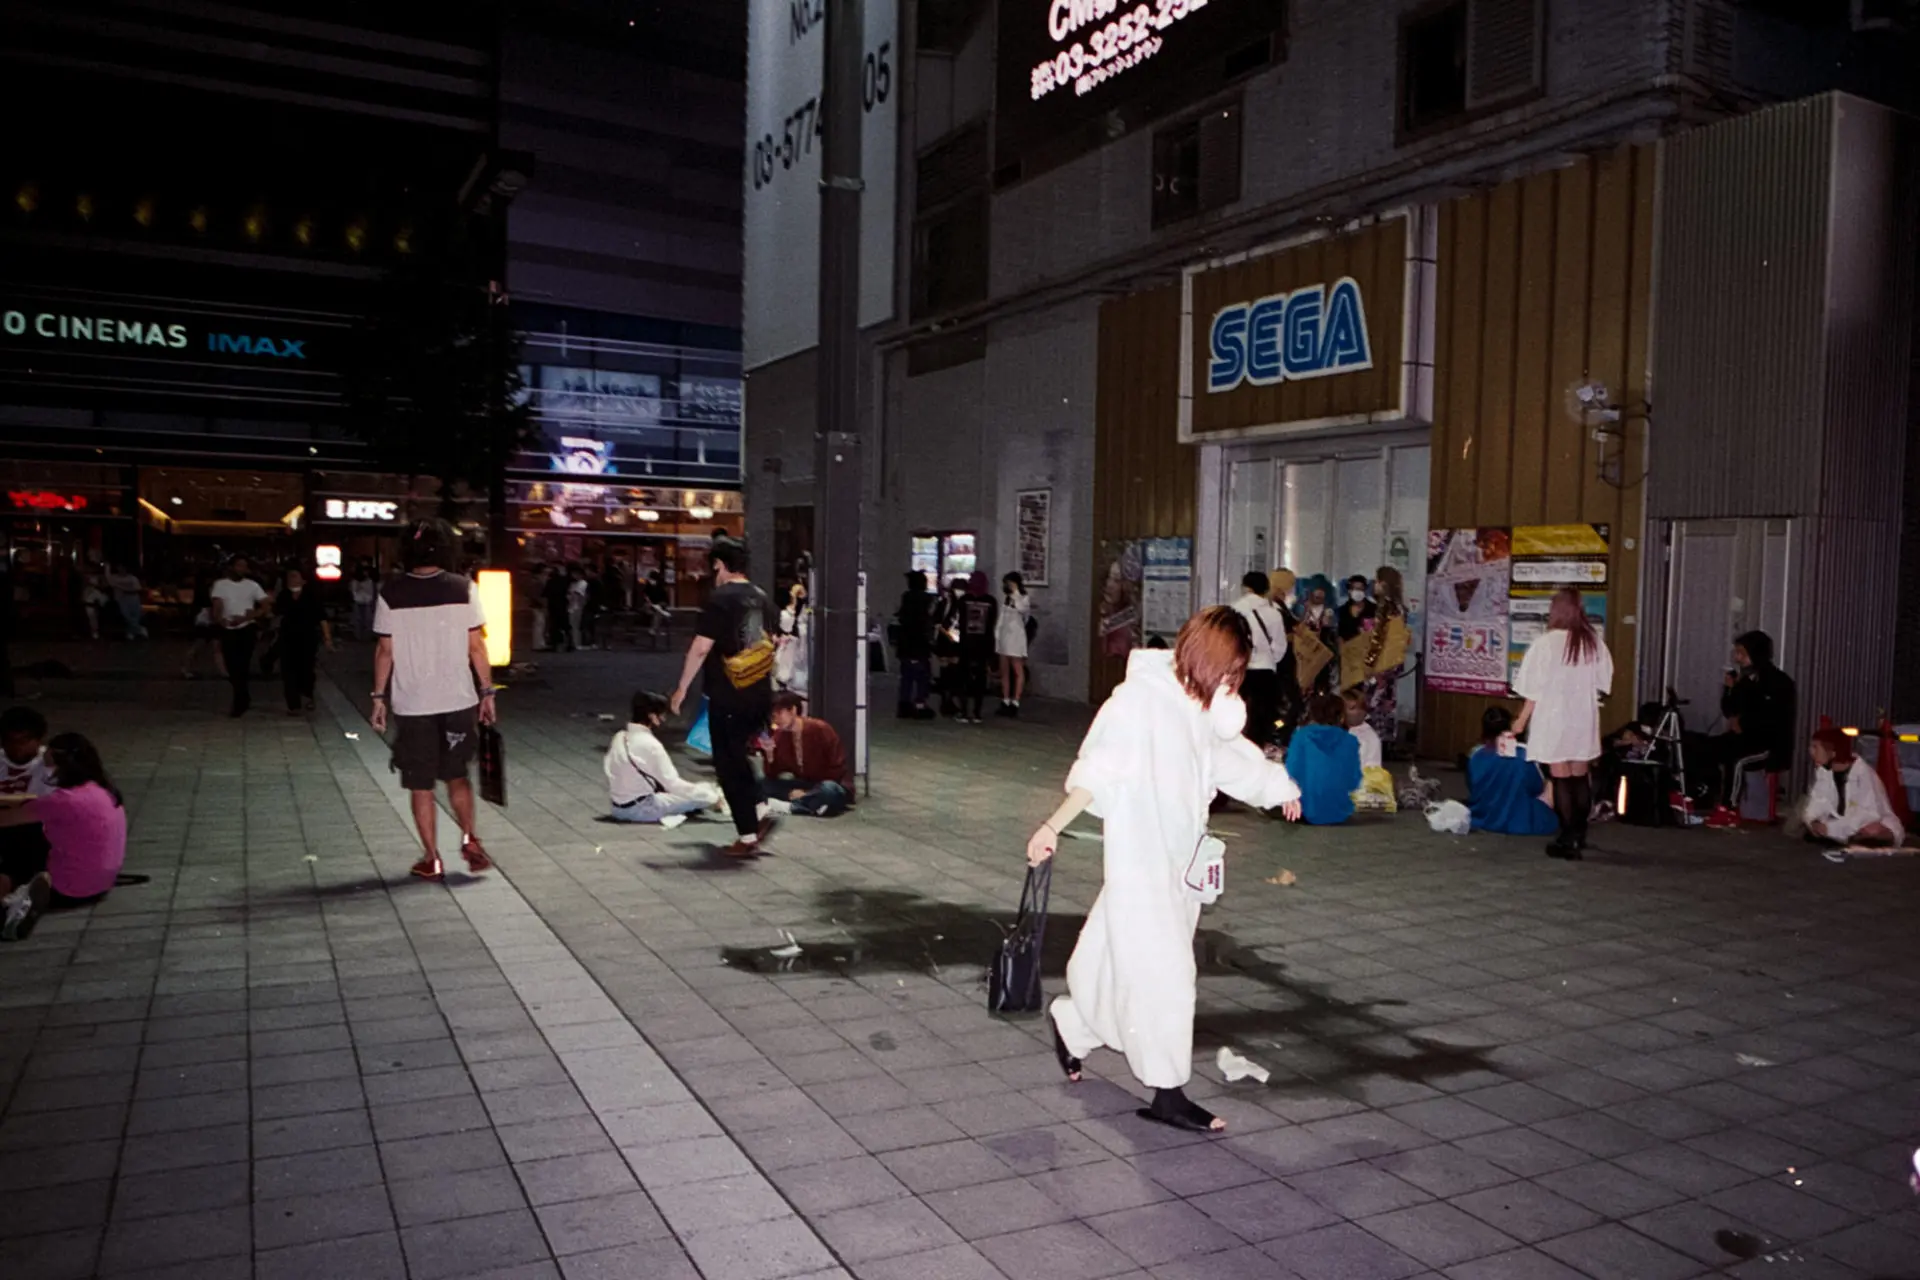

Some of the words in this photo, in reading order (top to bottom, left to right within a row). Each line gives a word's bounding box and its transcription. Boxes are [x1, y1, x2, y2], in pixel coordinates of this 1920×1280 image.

[35, 313, 188, 349] CINEMAS
[208, 332, 307, 359] IMAX
[1208, 277, 1372, 393] SEGA
